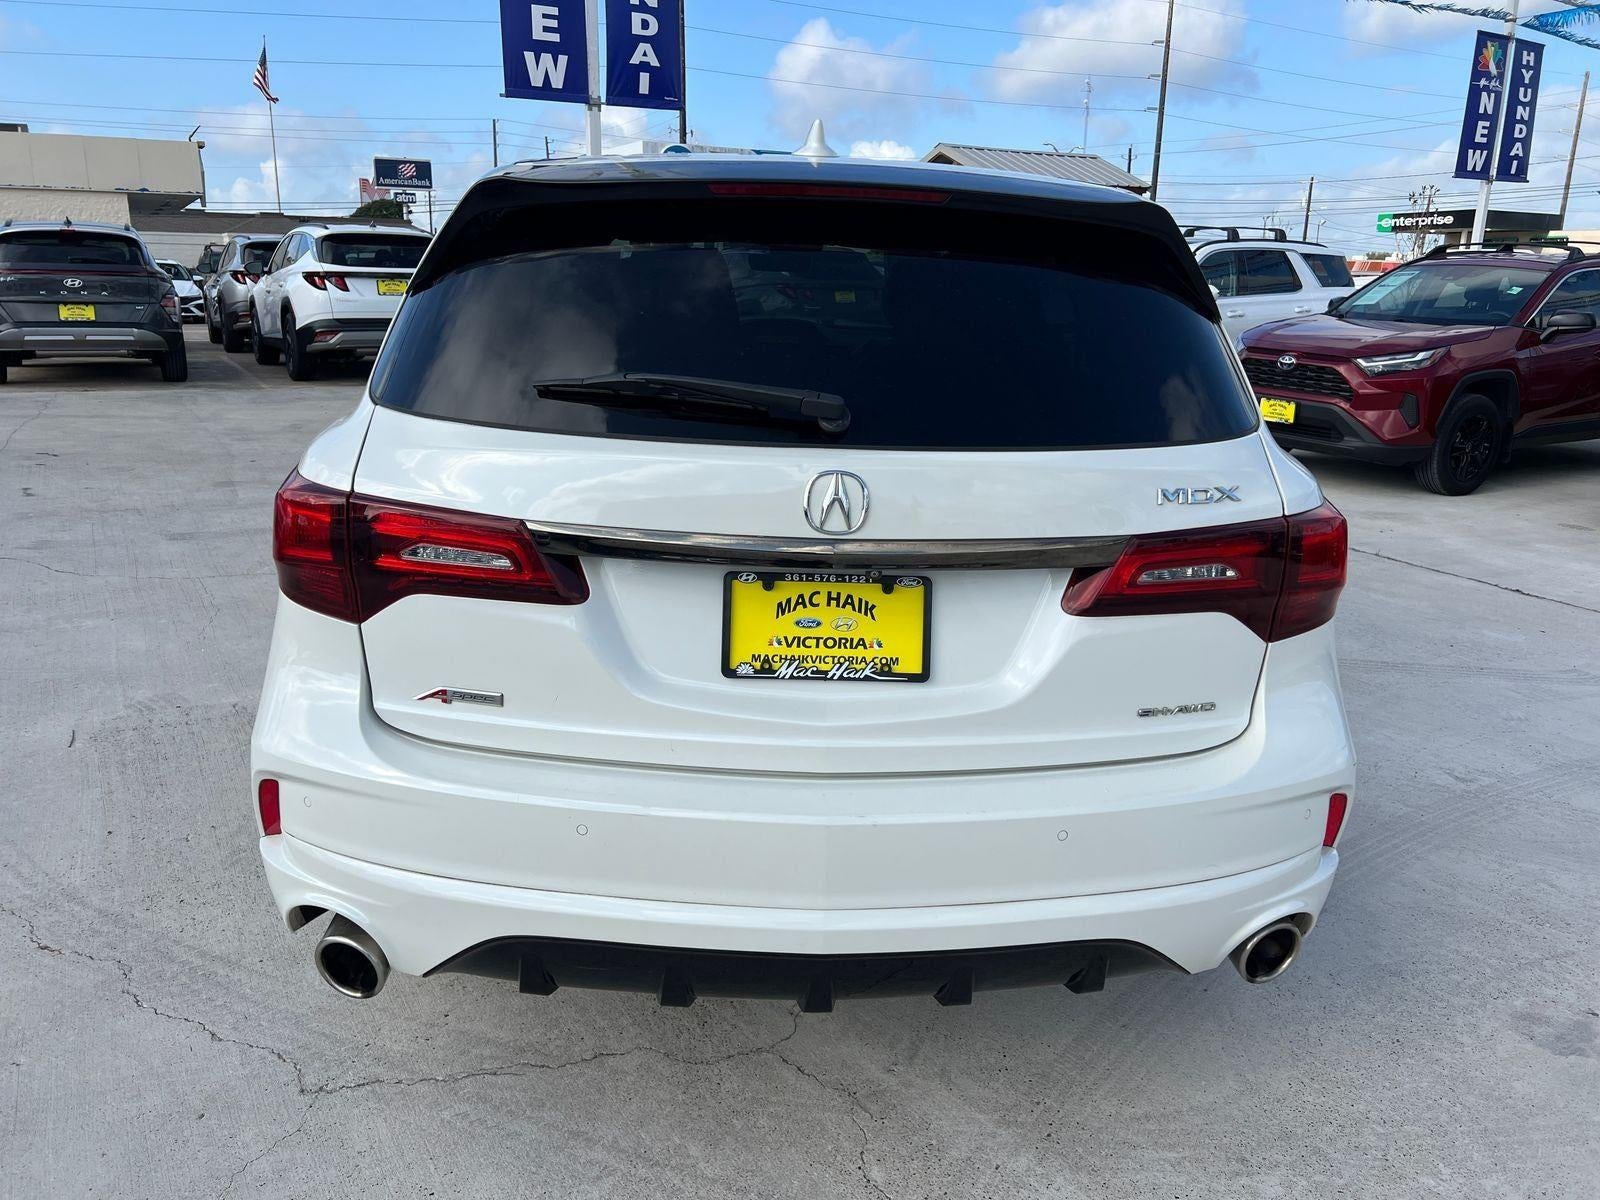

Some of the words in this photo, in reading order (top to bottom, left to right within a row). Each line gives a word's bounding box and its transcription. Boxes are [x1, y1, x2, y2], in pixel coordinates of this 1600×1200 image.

[1509, 50, 1535, 174] HYUNDAI
[1467, 91, 1495, 172] NEW
[396, 193, 416, 202] atm
[1379, 213, 1454, 228] enterprise
[1157, 485, 1242, 505] MDX
[900, 577, 919, 587] Ford
[775, 591, 821, 619] MAC
[826, 591, 877, 621] HAIK
[798, 618, 818, 628] Ford
[783, 636, 868, 650] VICTORIA
[773, 660, 825, 679] Mac
[827, 660, 881, 680] Haik
